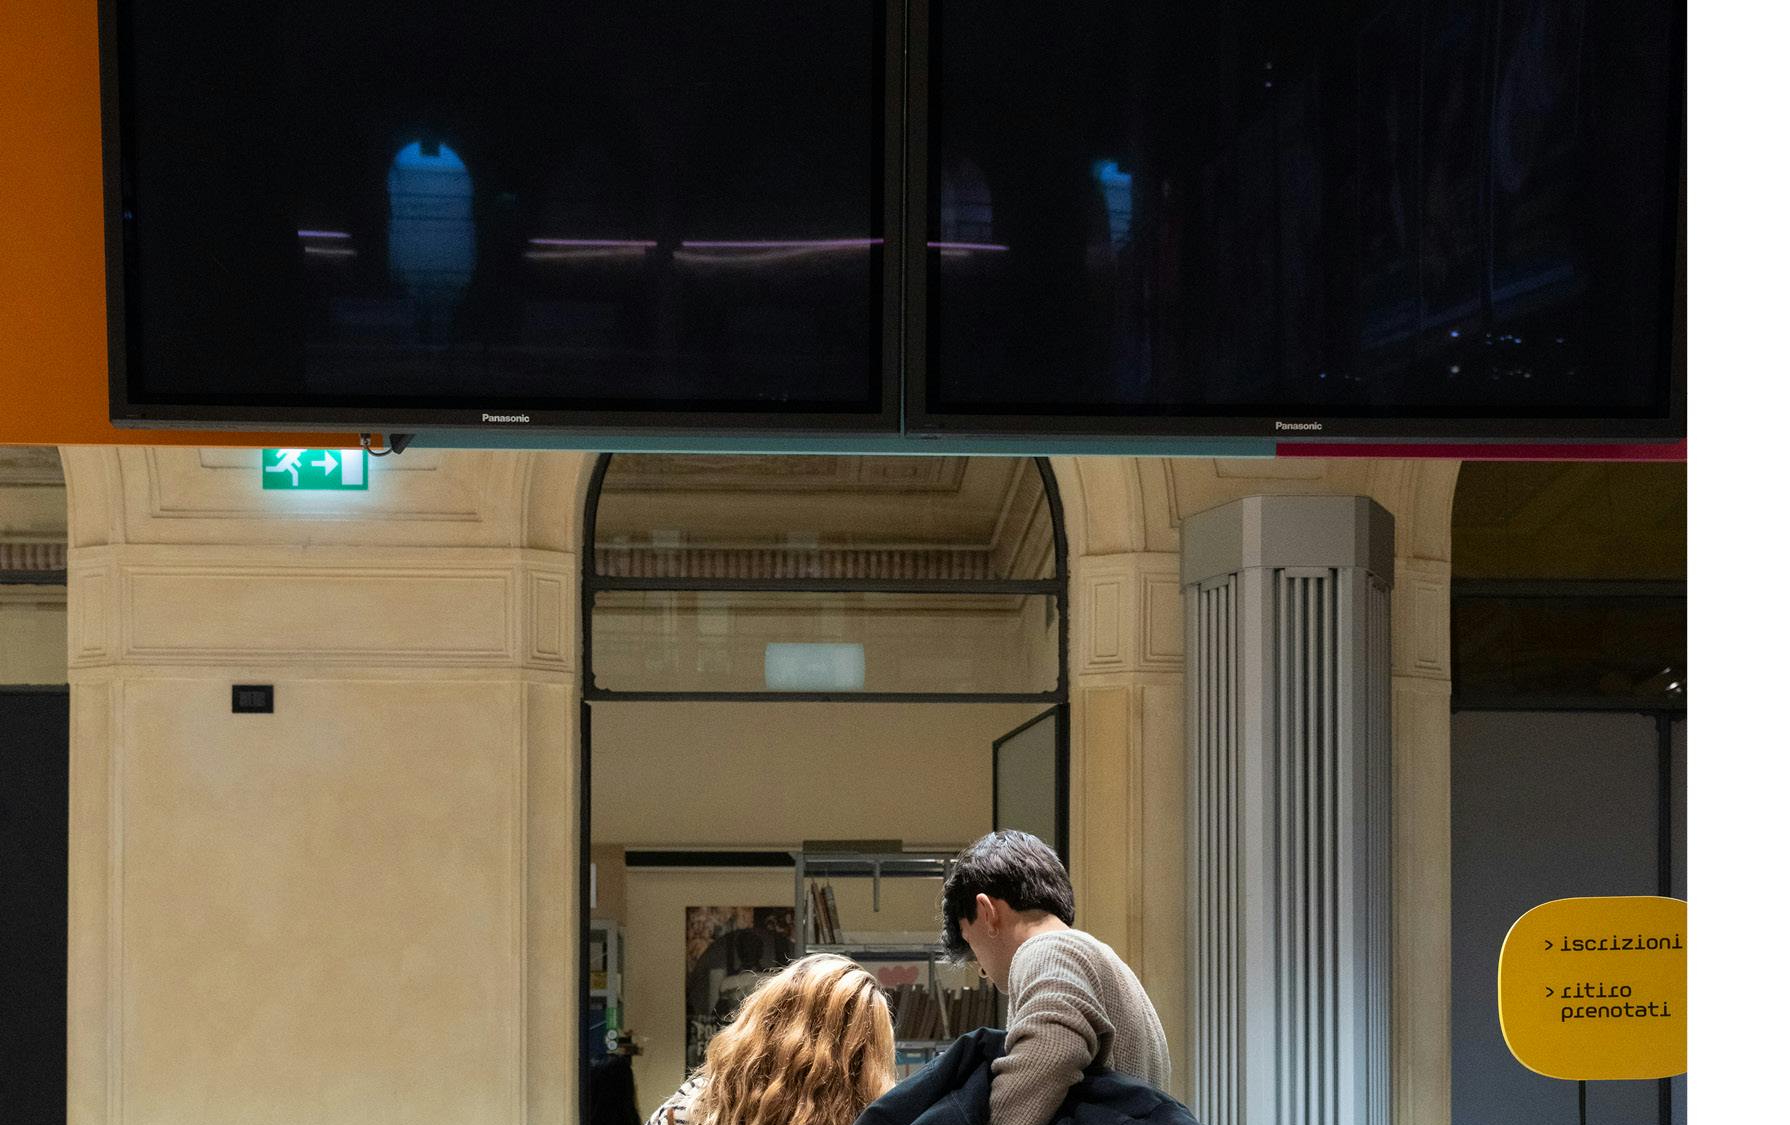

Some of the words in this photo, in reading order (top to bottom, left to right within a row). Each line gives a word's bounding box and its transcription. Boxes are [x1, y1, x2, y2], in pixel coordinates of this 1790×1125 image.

[482, 413, 530, 423] Panasonic
[1275, 421, 1323, 431] Panasonic
[1560, 934, 1683, 952] iscrizioni
[1561, 982, 1632, 999] ritiro
[1561, 1002, 1671, 1022] prenotati
